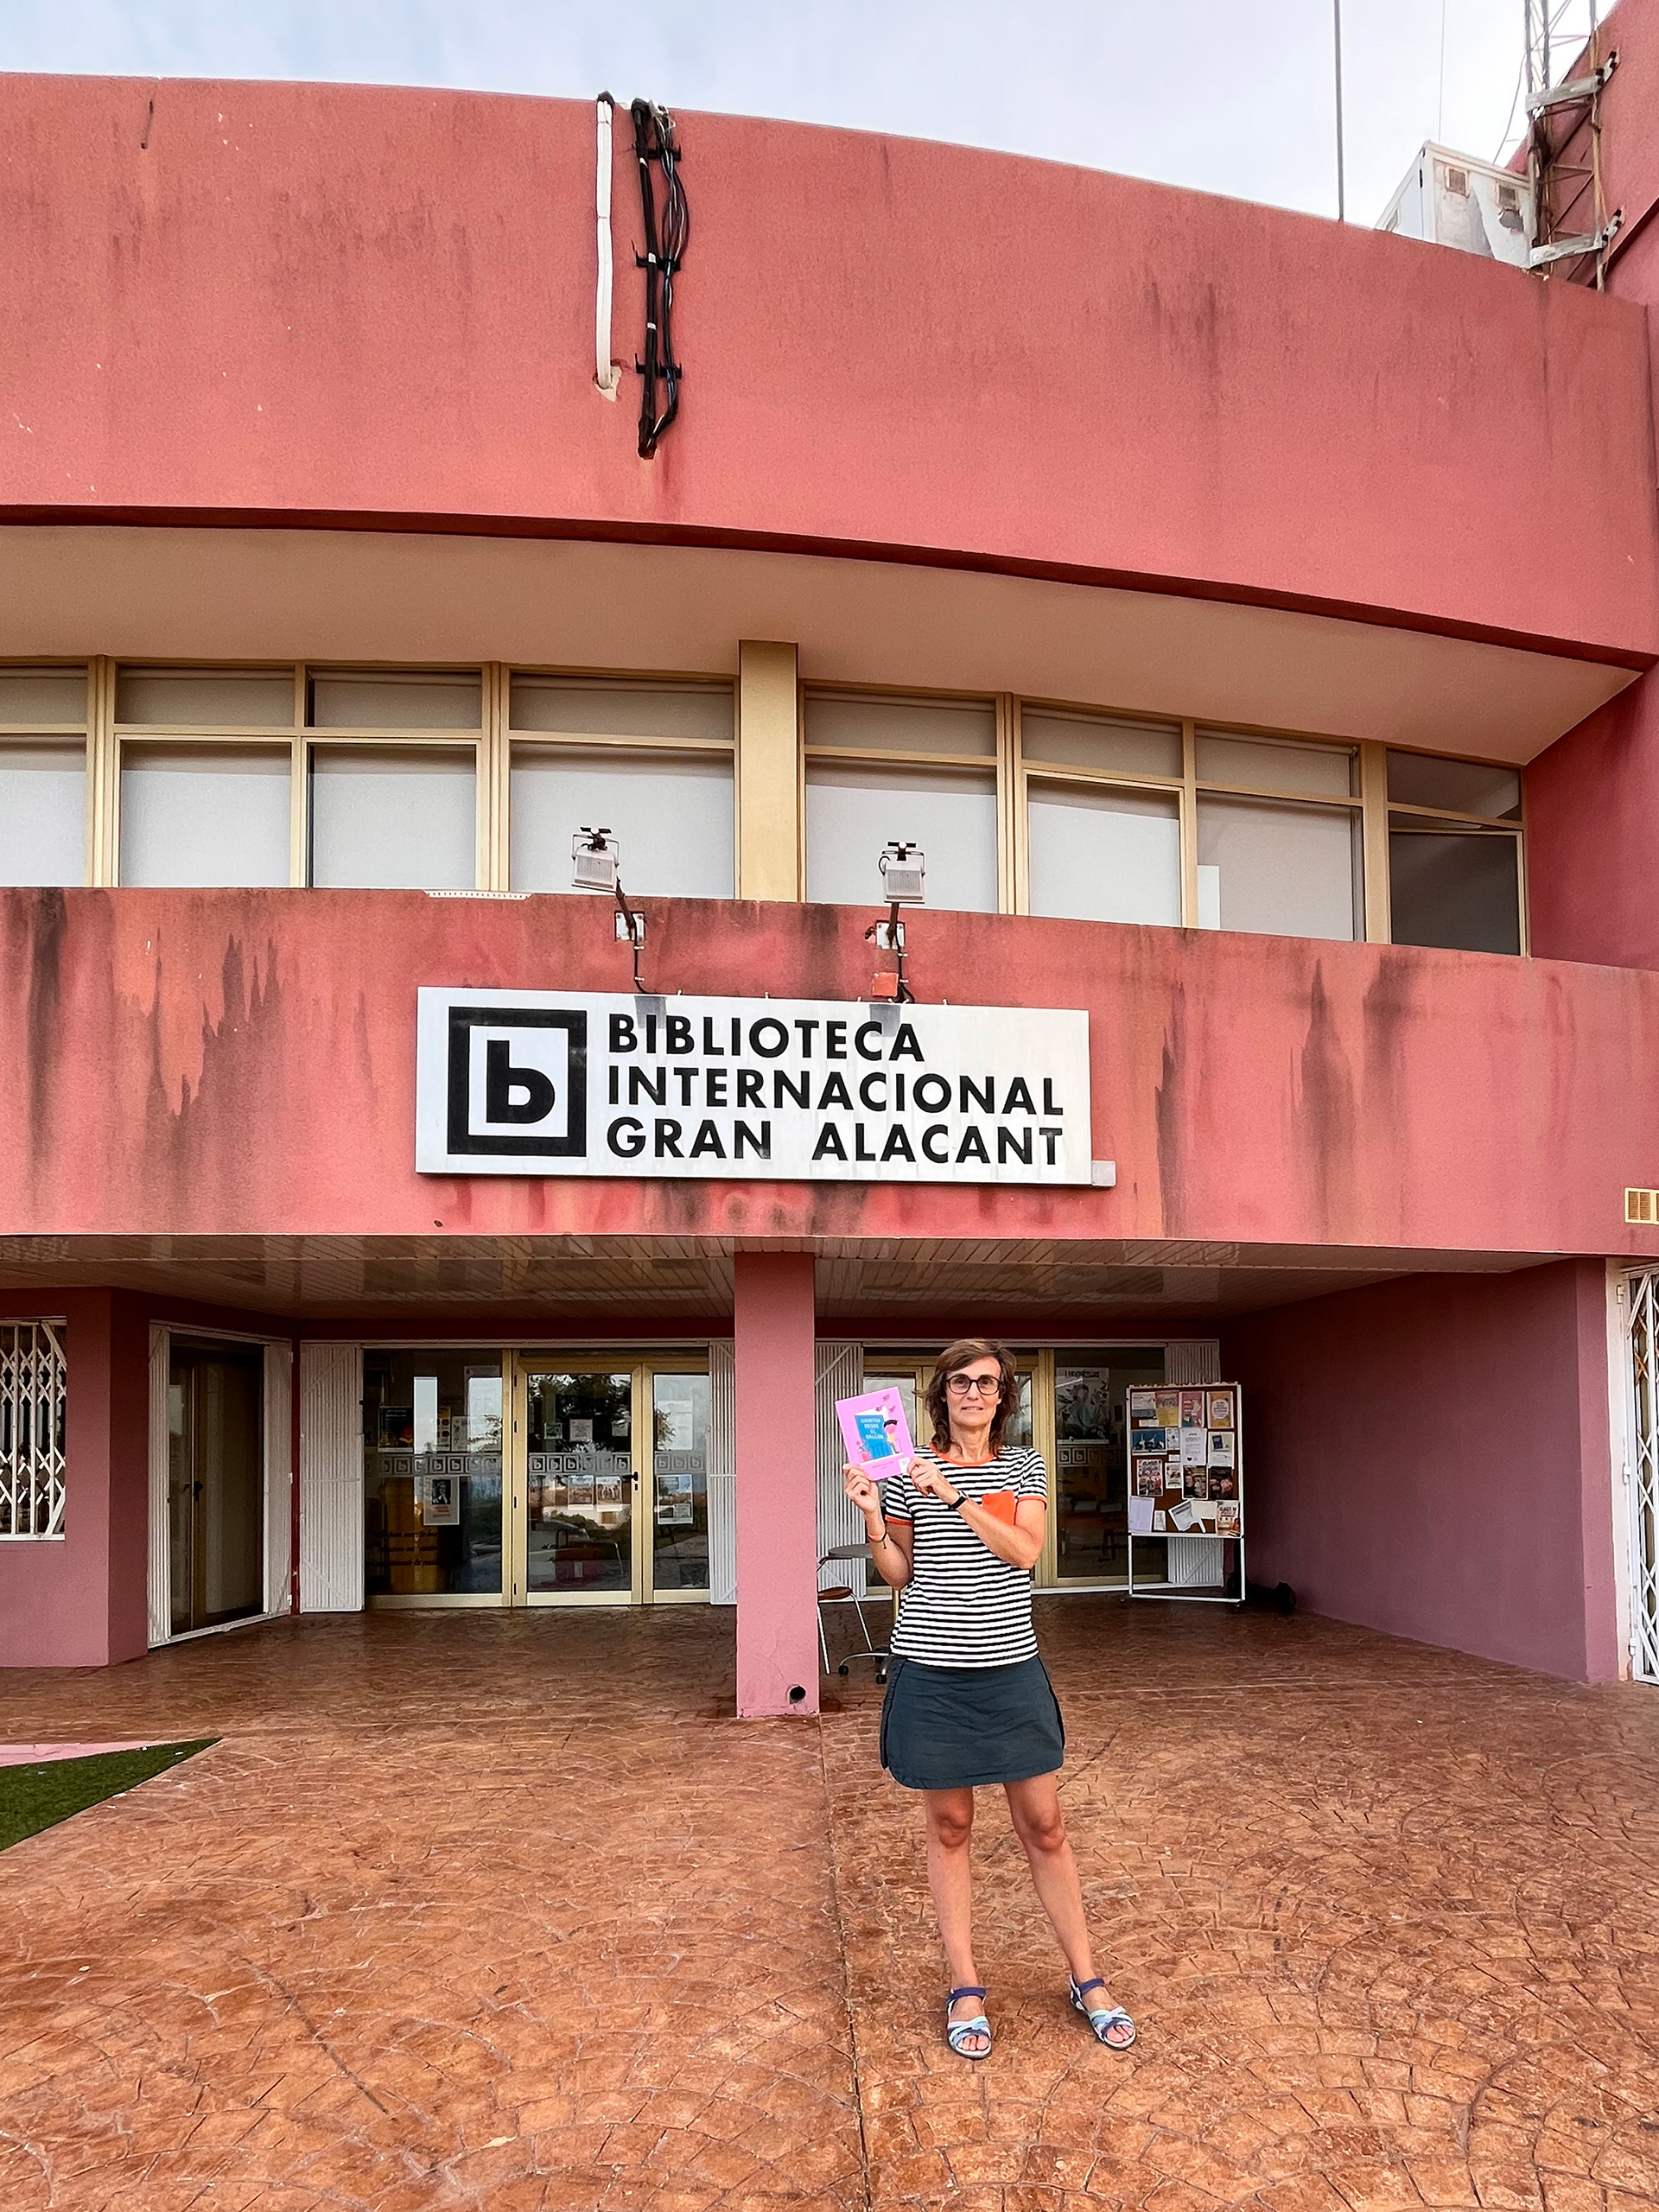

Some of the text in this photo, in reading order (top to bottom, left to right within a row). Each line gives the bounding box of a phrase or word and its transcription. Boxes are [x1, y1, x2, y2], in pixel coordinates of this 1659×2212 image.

[608, 1013, 925, 1062] BIBLIOTECA
[608, 1065, 1064, 1116] INTERNACIONAL
[607, 1116, 1064, 1166] GRAN ALACANT
